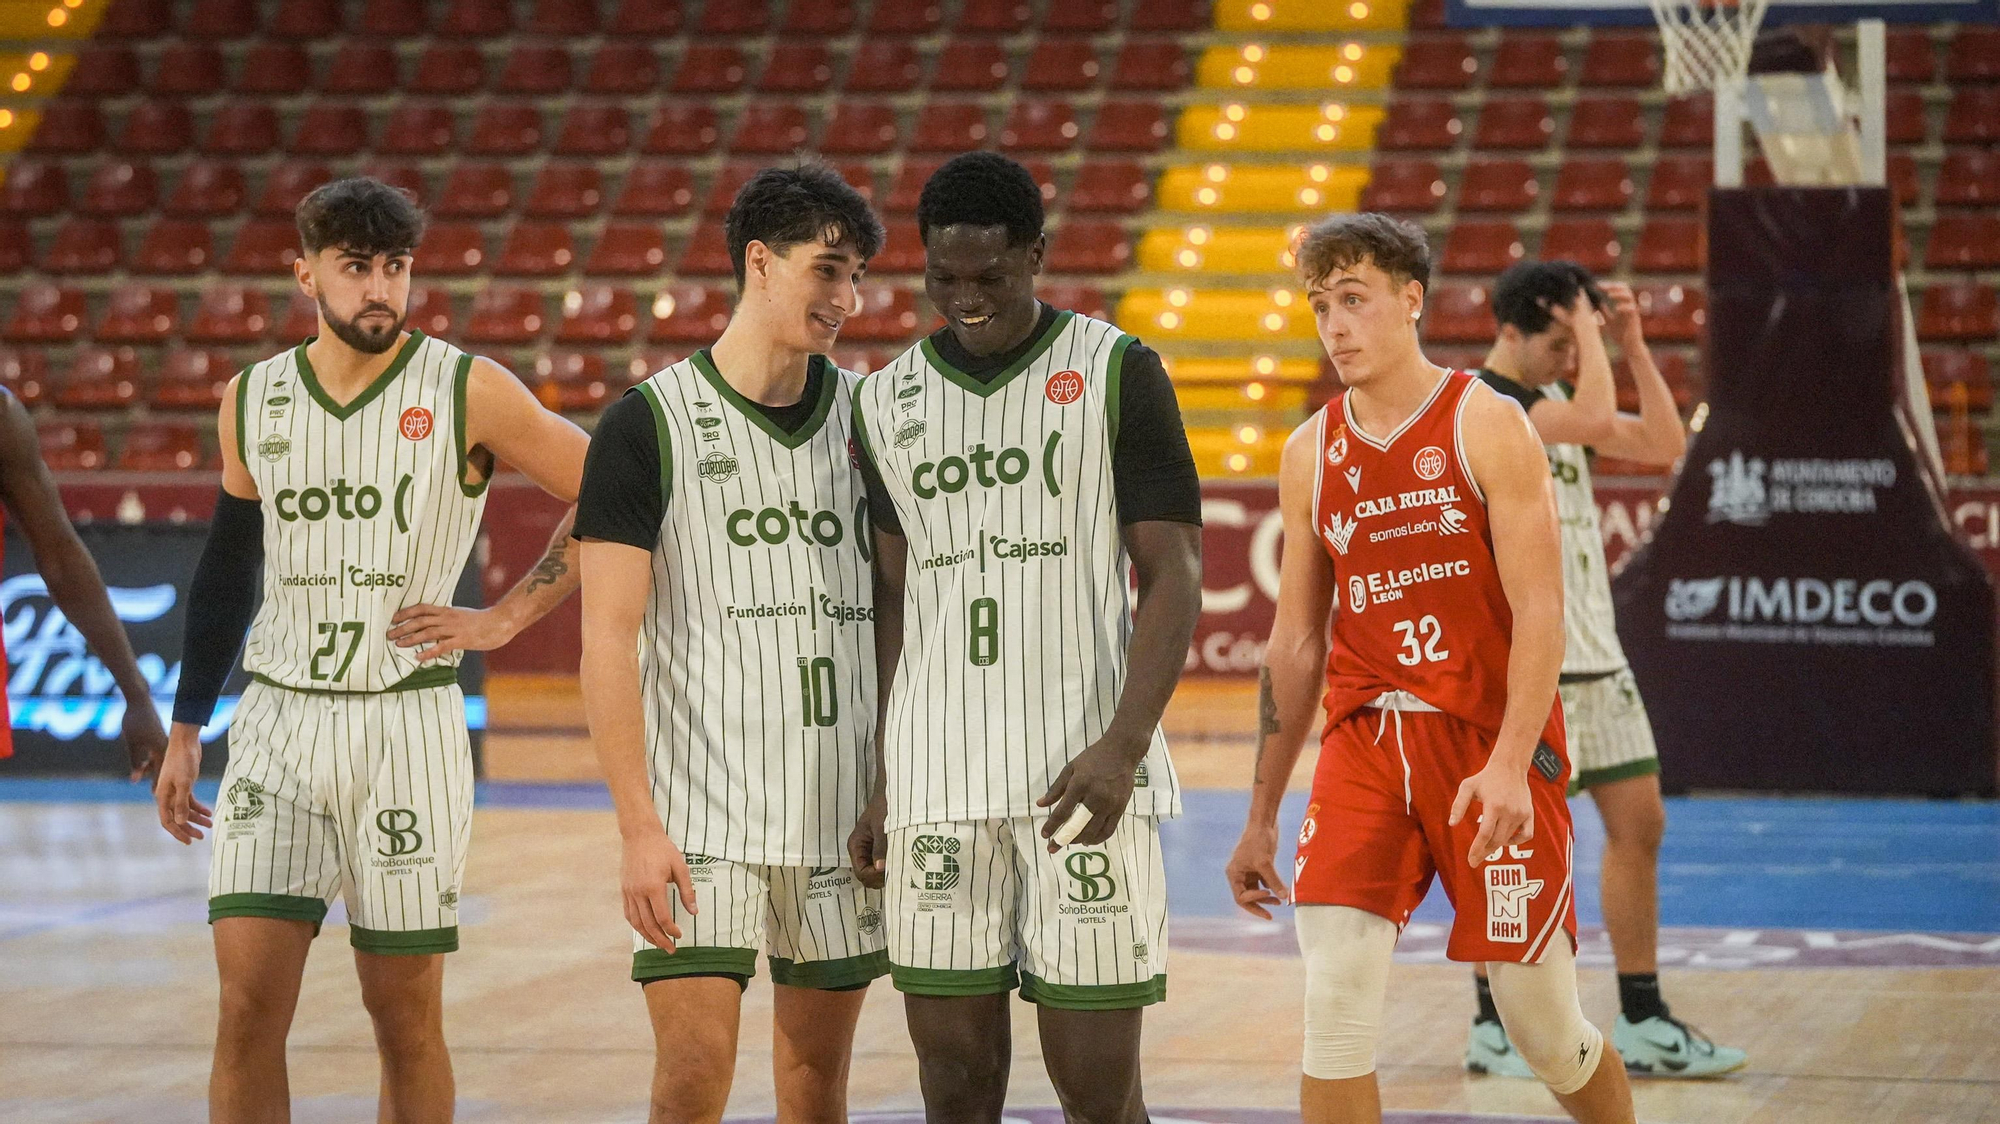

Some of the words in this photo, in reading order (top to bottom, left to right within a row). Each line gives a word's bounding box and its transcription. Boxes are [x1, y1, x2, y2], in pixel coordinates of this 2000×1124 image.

[901, 400, 918, 410] PRO
[702, 431, 720, 439] PRO
[912, 443, 1030, 500] coto
[275, 478, 382, 522] coto
[1354, 496, 1397, 519] CAJA
[1398, 486, 1462, 509] RURAL
[726, 501, 843, 547] coto
[922, 548, 974, 570] ndación
[990, 535, 1068, 563] Cajasol
[348, 565, 406, 592] Cajaso
[1367, 560, 1470, 593] E.Leclerc
[726, 602, 807, 619] Fundación
[819, 593, 875, 626] Cajaso
[1372, 589, 1403, 605] LEÓN
[1727, 575, 1938, 627] IMDECO
[970, 597, 998, 666] 8
[1393, 615, 1450, 666] 32
[310, 622, 365, 682] 27
[797, 656, 838, 727] 10
[387, 868, 412, 876] HOTELS
[690, 867, 713, 875] IERRA
[808, 876, 851, 890] Boutique
[1490, 869, 1521, 886] BUN
[1078, 916, 1106, 924] HOTELS
[1492, 921, 1521, 939] HAM
